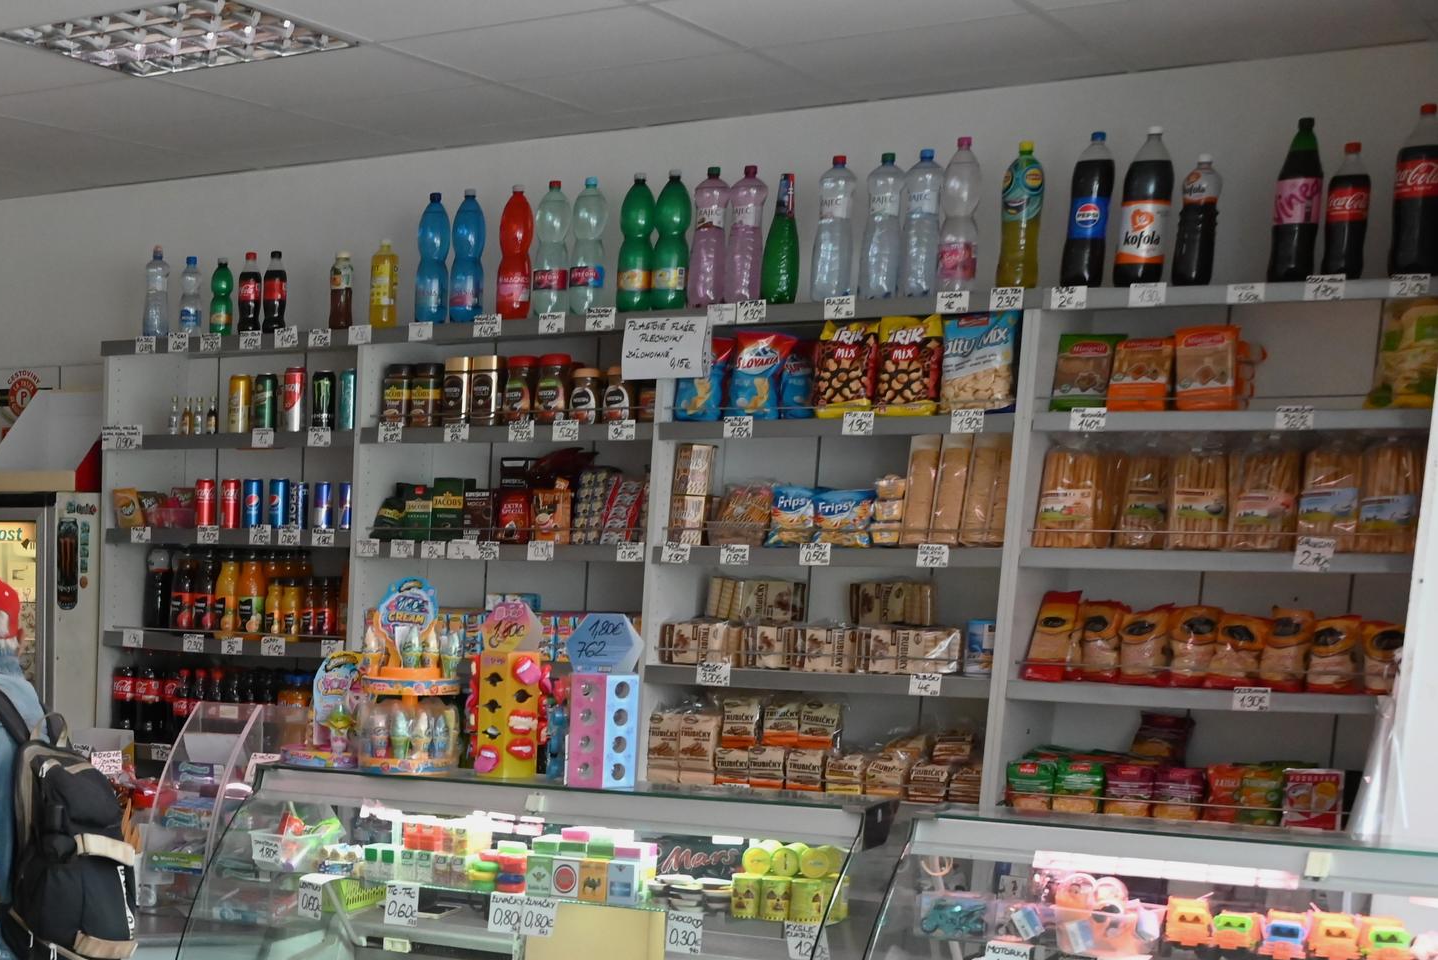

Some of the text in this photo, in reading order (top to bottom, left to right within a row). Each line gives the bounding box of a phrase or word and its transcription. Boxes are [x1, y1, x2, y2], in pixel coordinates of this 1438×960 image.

[1076, 211, 1100, 219] PEPSI
[1123, 230, 1161, 249] kofola
[1057, 295, 1073, 309] 2€
[831, 326, 864, 344] TRIK
[887, 327, 924, 344] TRIK
[834, 346, 857, 359] MIX
[891, 347, 915, 360] MIX
[669, 357, 692, 371] 0,15€
[736, 355, 780, 369] SLOVAKIA
[846, 419, 873, 433] 1,90€
[433, 498, 462, 507] JACOBS
[776, 495, 813, 511] Fripsy
[817, 500, 856, 514] Fripsy
[803, 550, 829, 562] 0,50€
[388, 612, 425, 624] CREAM
[588, 620, 624, 639] 1,80€
[577, 640, 608, 658] 762
[917, 683, 931, 692] 4€
[723, 712, 754, 722] TRUBIČKY
[802, 713, 835, 725] TRUBIČKY
[648, 727, 679, 738] TRUBIČKY
[681, 727, 711, 738] TRUBIČKY
[717, 759, 748, 768] TRUBIČKY
[749, 759, 782, 769] TRUBIČKY
[789, 761, 822, 772] TRUBIČKY
[662, 845, 740, 874] Mars
[301, 893, 322, 911] 0,60€
[386, 900, 417, 919] 0,60€
[523, 911, 554, 928] 0,80€
[669, 914, 693, 924] CHOCO
[668, 928, 701, 948] 0,30€
[987, 945, 1028, 959] MOTORKA
